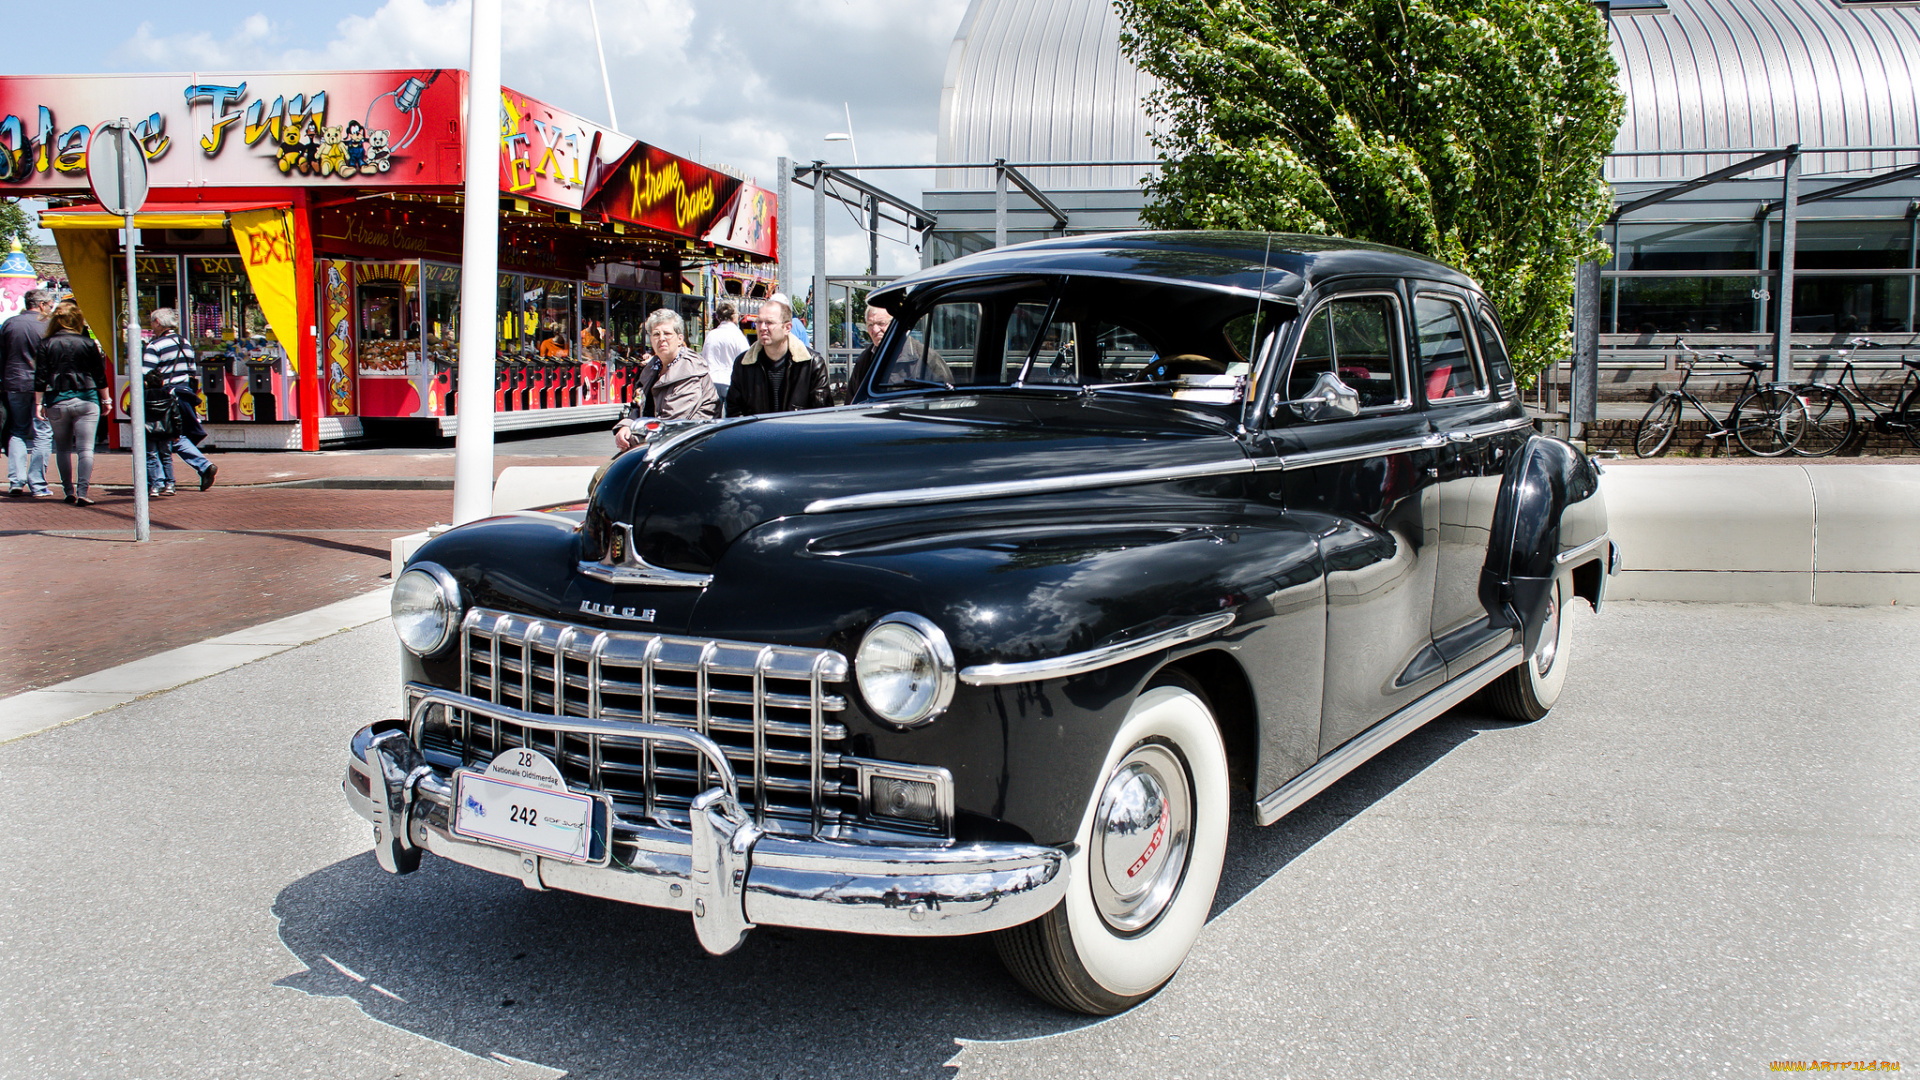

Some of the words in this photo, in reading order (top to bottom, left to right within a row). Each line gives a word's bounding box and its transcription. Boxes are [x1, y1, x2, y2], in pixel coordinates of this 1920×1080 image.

[184, 81, 326, 152] Fun
[630, 158, 680, 219] X-treme
[675, 178, 715, 229] Cranes
[345, 215, 390, 247] X-treme
[392, 226, 428, 251] Cranes
[492, 764, 520, 777] Nationale
[521, 770, 559, 786] Oldtimerdag
[510, 804, 538, 827] 242
